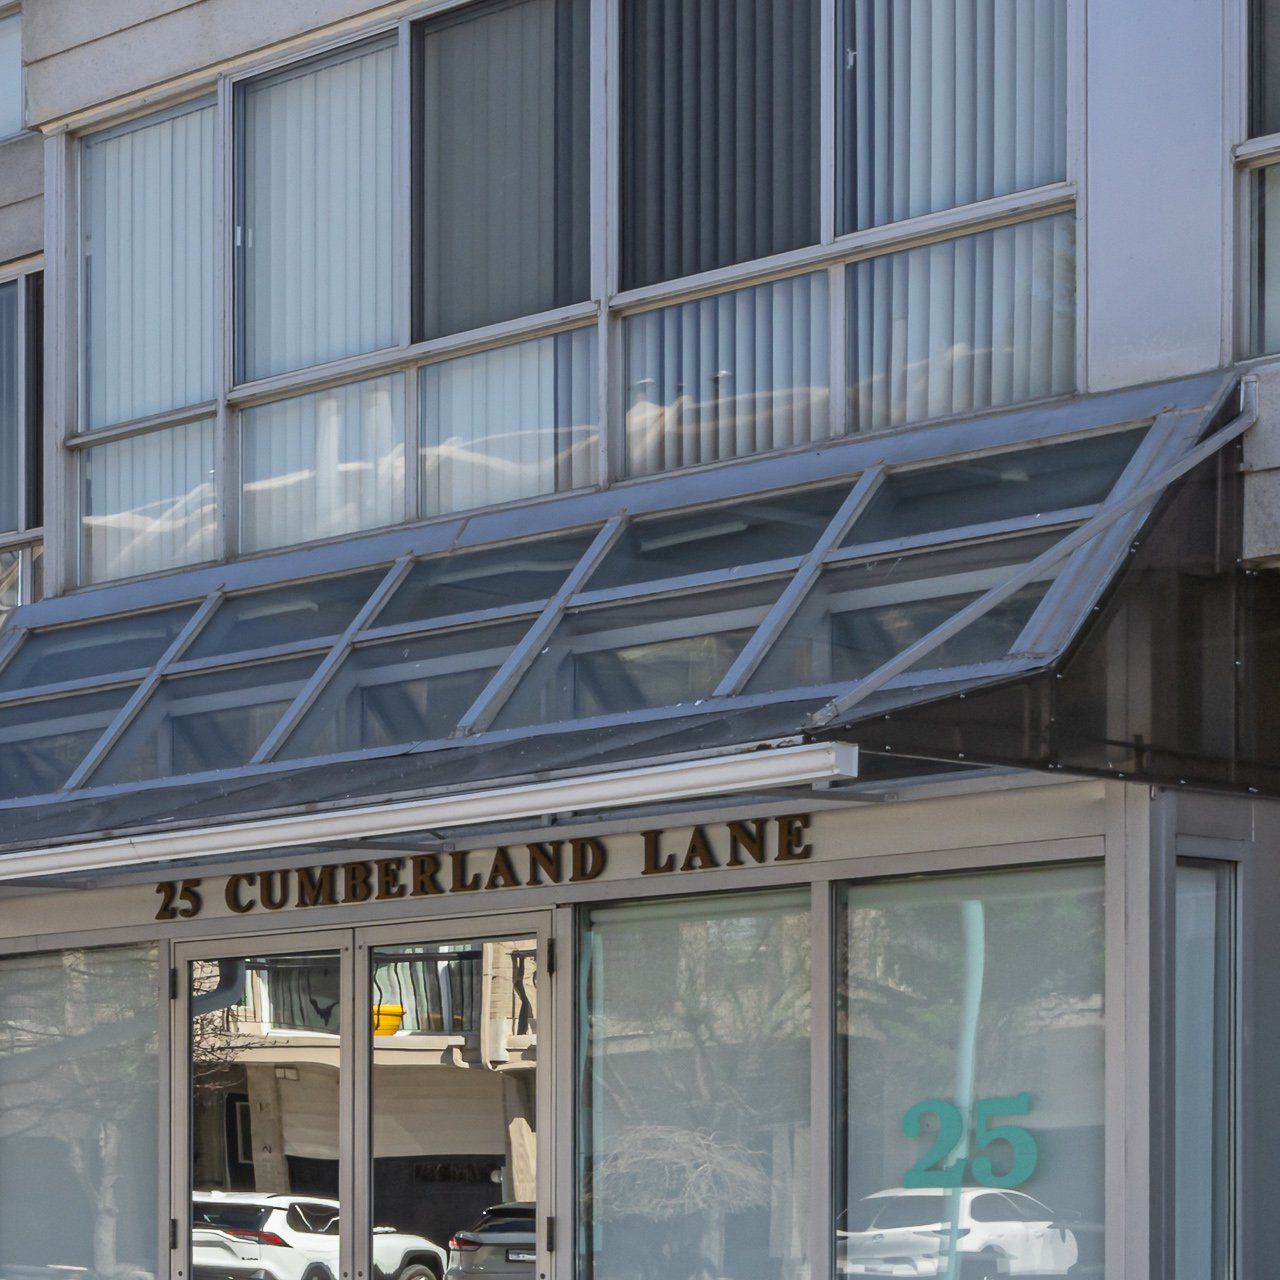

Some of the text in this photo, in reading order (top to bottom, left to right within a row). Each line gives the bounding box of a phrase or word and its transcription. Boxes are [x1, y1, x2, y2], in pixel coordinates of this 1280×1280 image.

[155, 813, 813, 920] 25 CUMBERLAND LANE
[902, 1091, 1038, 1189] 25
